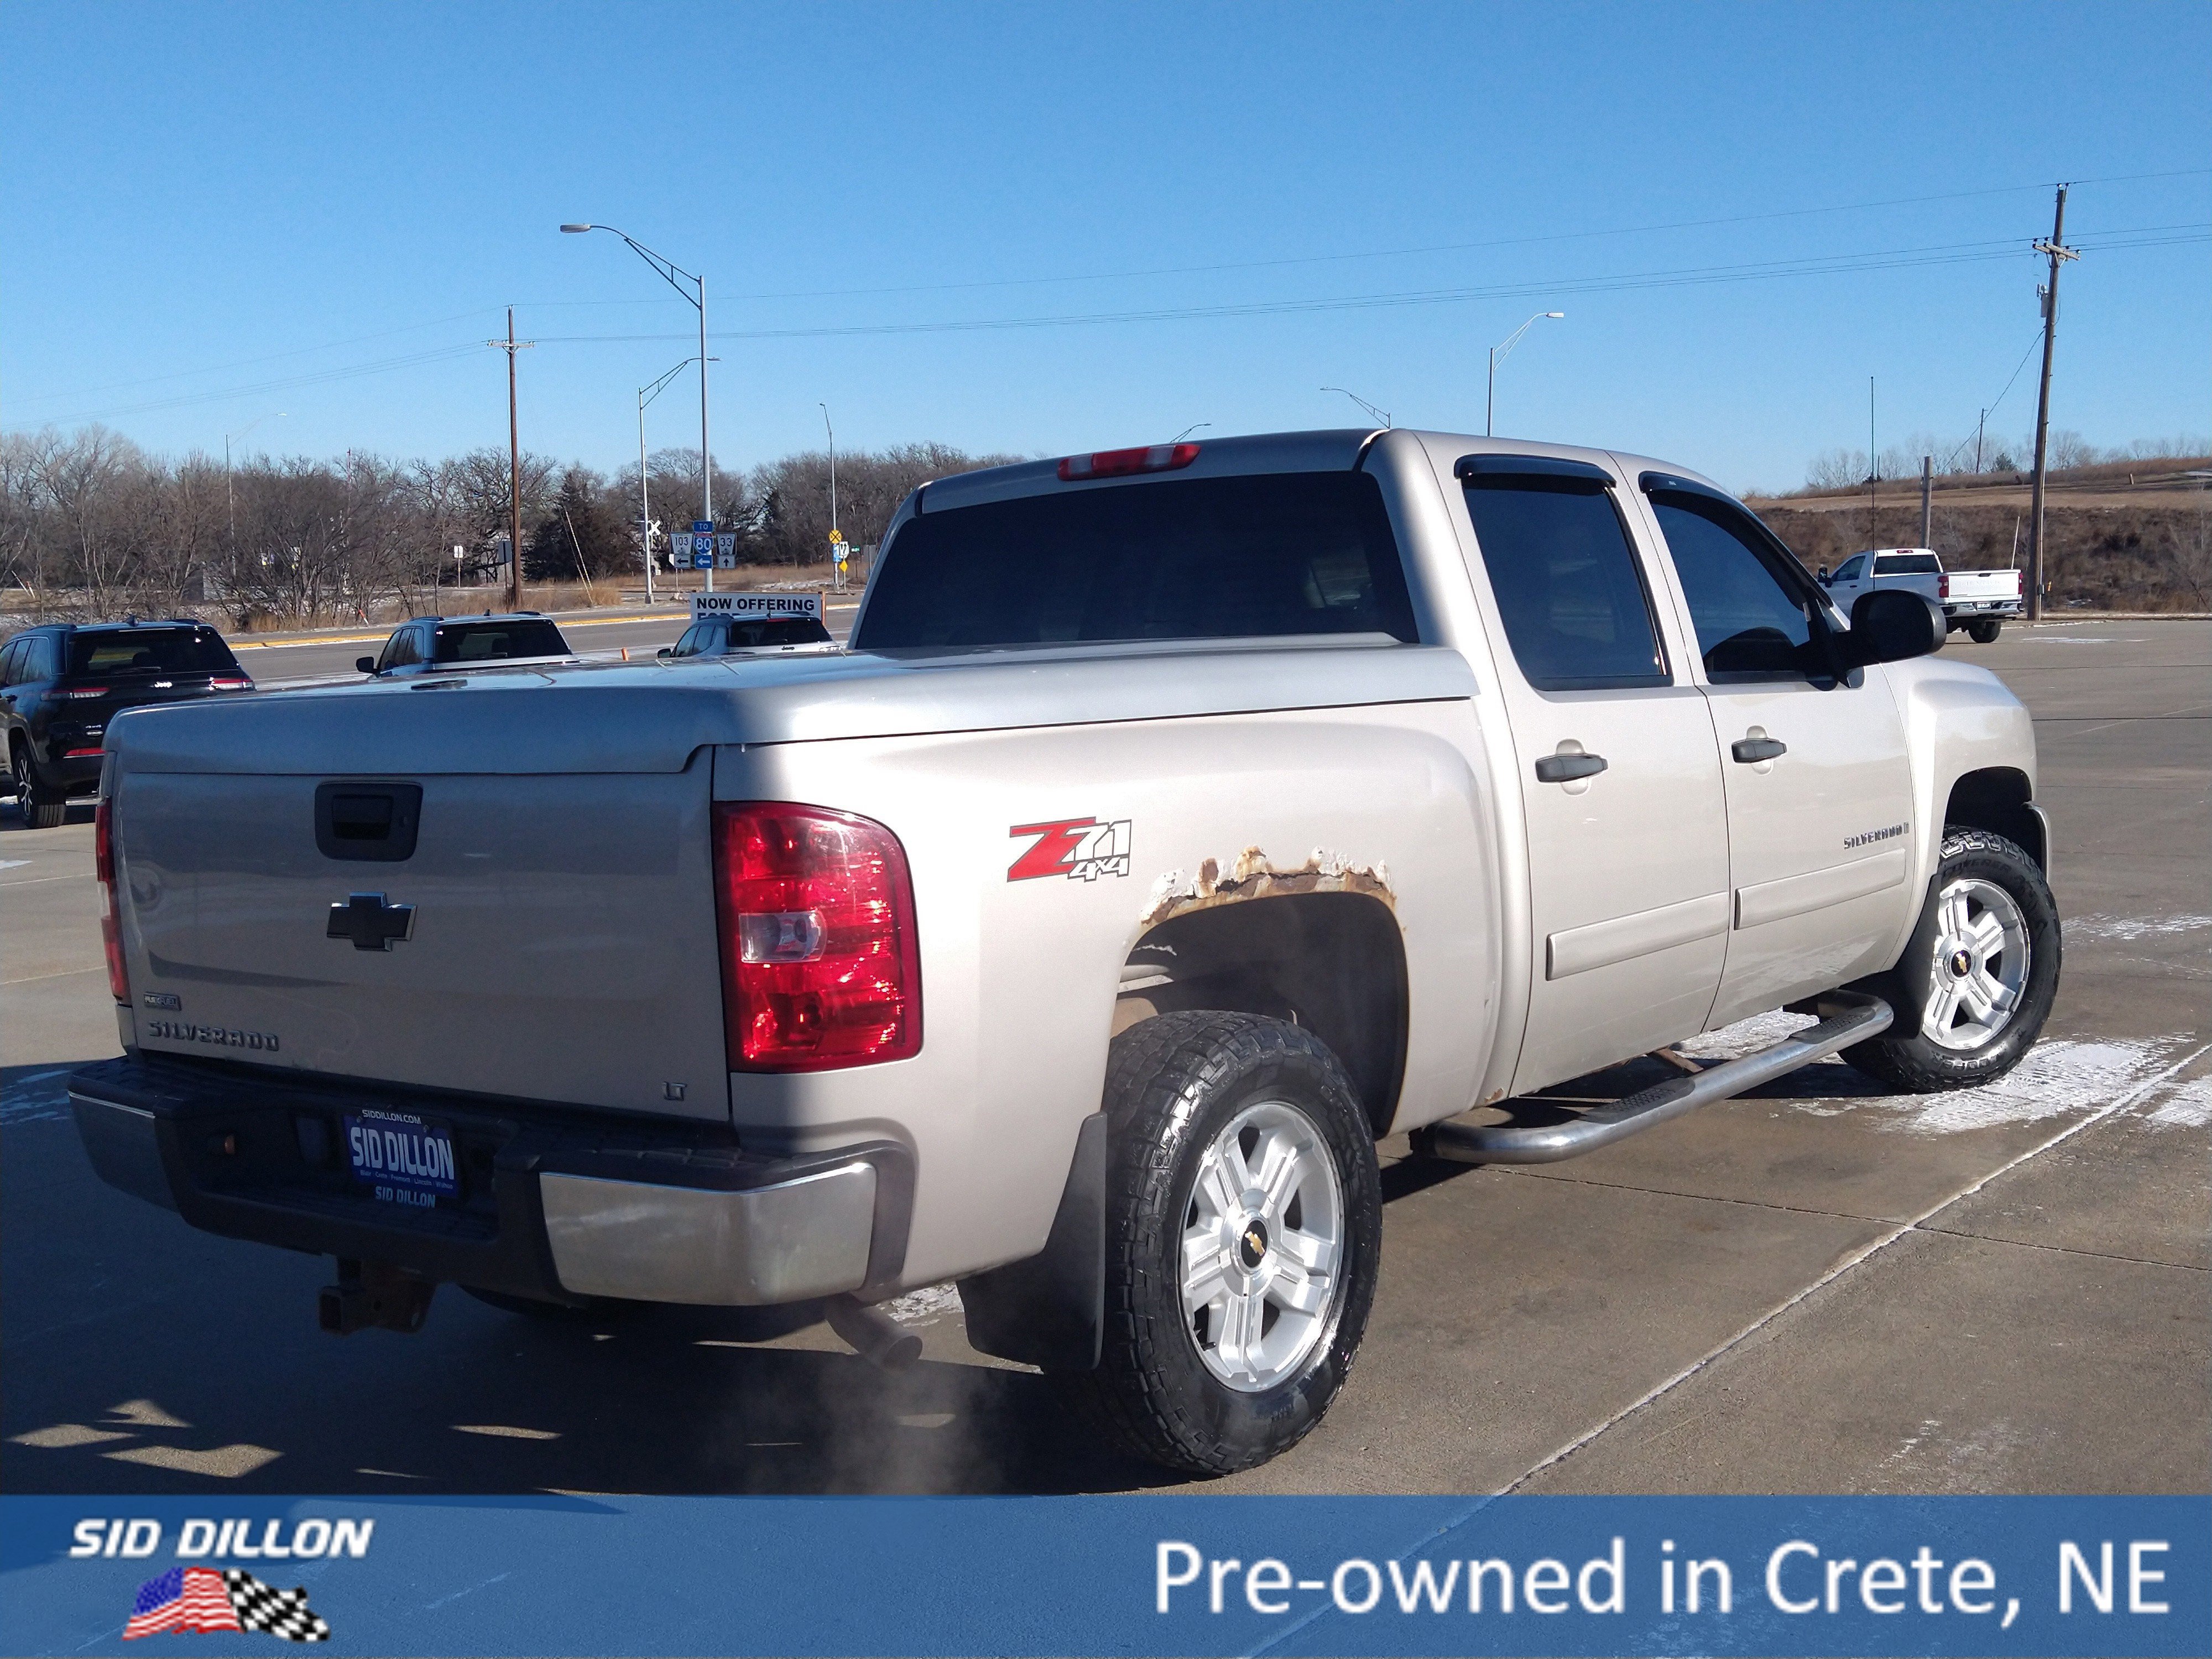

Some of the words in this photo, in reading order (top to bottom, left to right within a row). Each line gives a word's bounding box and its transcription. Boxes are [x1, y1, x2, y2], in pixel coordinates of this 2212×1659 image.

[675, 536, 688, 546] 103
[696, 538, 712, 550] 80
[720, 538, 732, 547] 33
[697, 598, 732, 609] NOW
[737, 598, 815, 611] OFFERING
[1844, 824, 1903, 850] SILVERADO
[1007, 816, 1131, 883] Z71
[149, 1021, 279, 1052] SILVERADO
[662, 1081, 687, 1101] LT
[362, 1109, 421, 1124] SIDDILLON.COM
[351, 1126, 383, 1168] SID
[384, 1131, 455, 1180] DILLON
[375, 1186, 393, 1202] SID
[397, 1189, 435, 1208] DILLON
